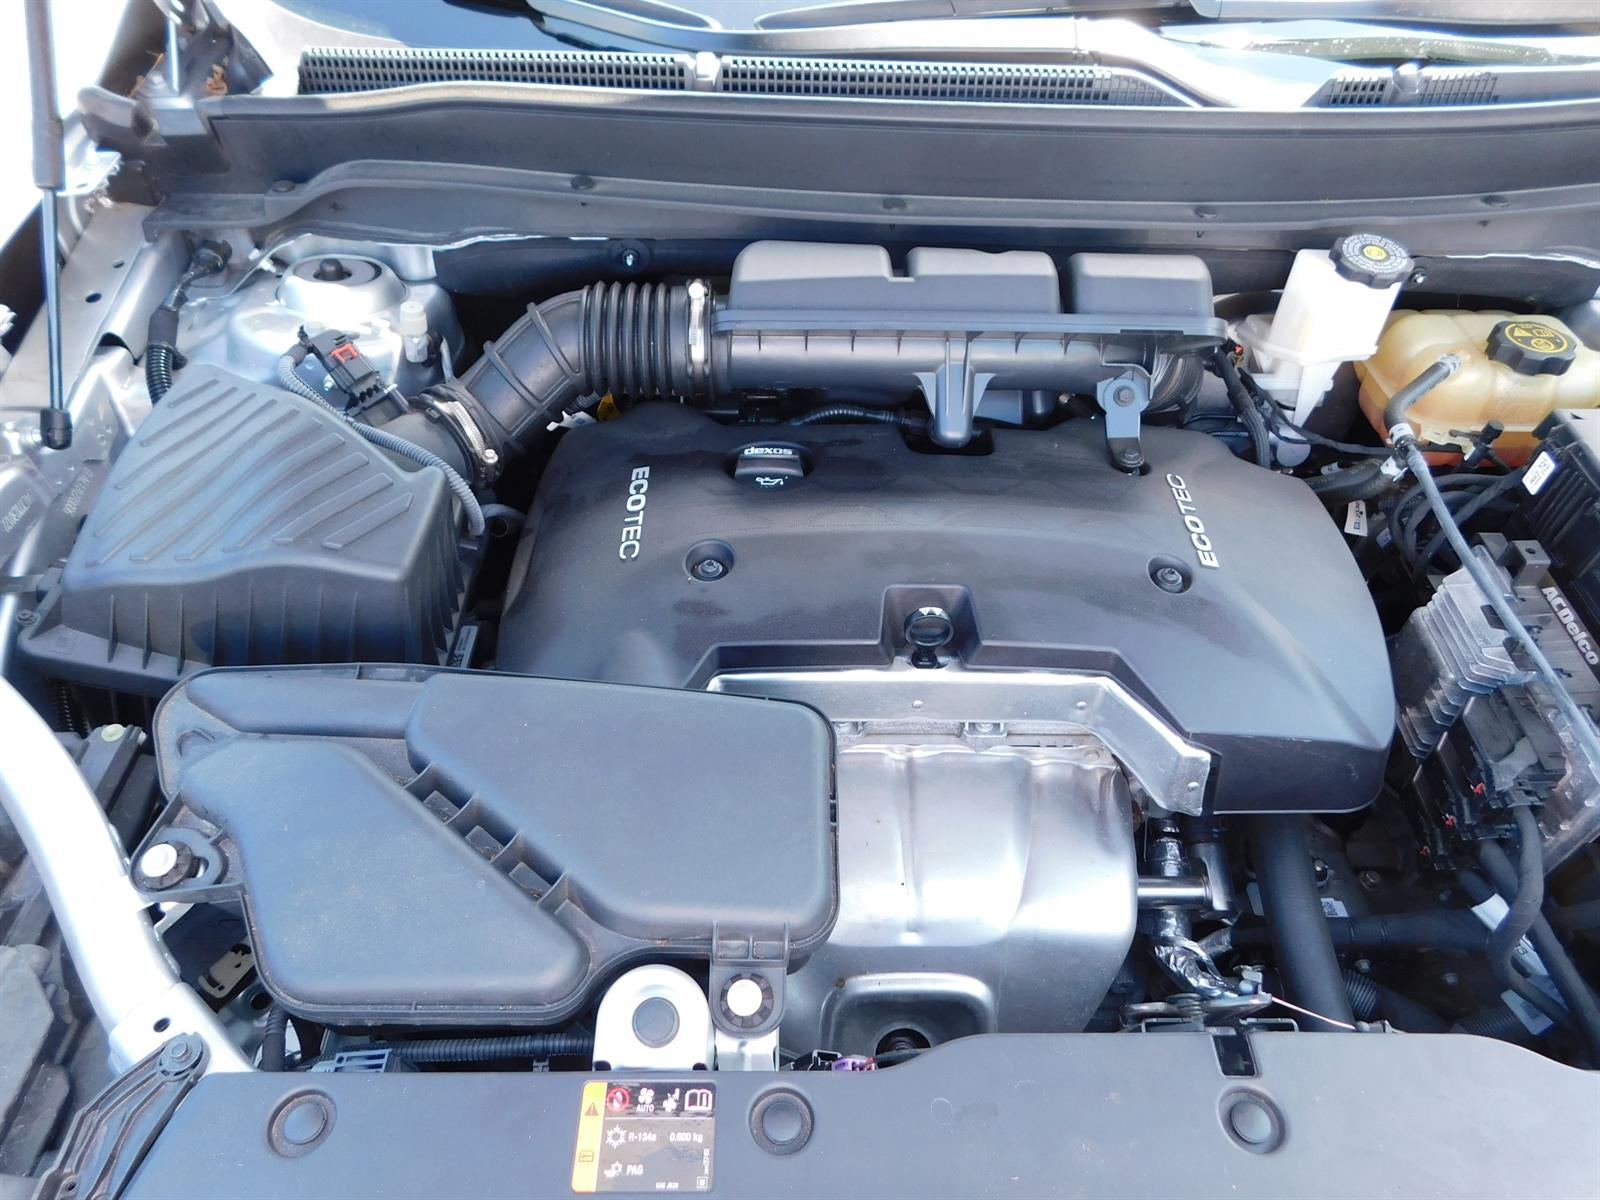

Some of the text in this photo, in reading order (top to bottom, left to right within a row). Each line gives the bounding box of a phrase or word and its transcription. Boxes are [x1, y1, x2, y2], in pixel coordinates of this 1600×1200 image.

[744, 447, 793, 455] dexos
[619, 466, 650, 560] ECOTEC
[1166, 473, 1220, 568] ECOTEC
[1541, 586, 1599, 665] ACDelco
[635, 1104, 655, 1113] AUTO
[628, 1132, 657, 1142] R-134a
[692, 1132, 704, 1144] kg
[626, 1164, 645, 1176] PAG
